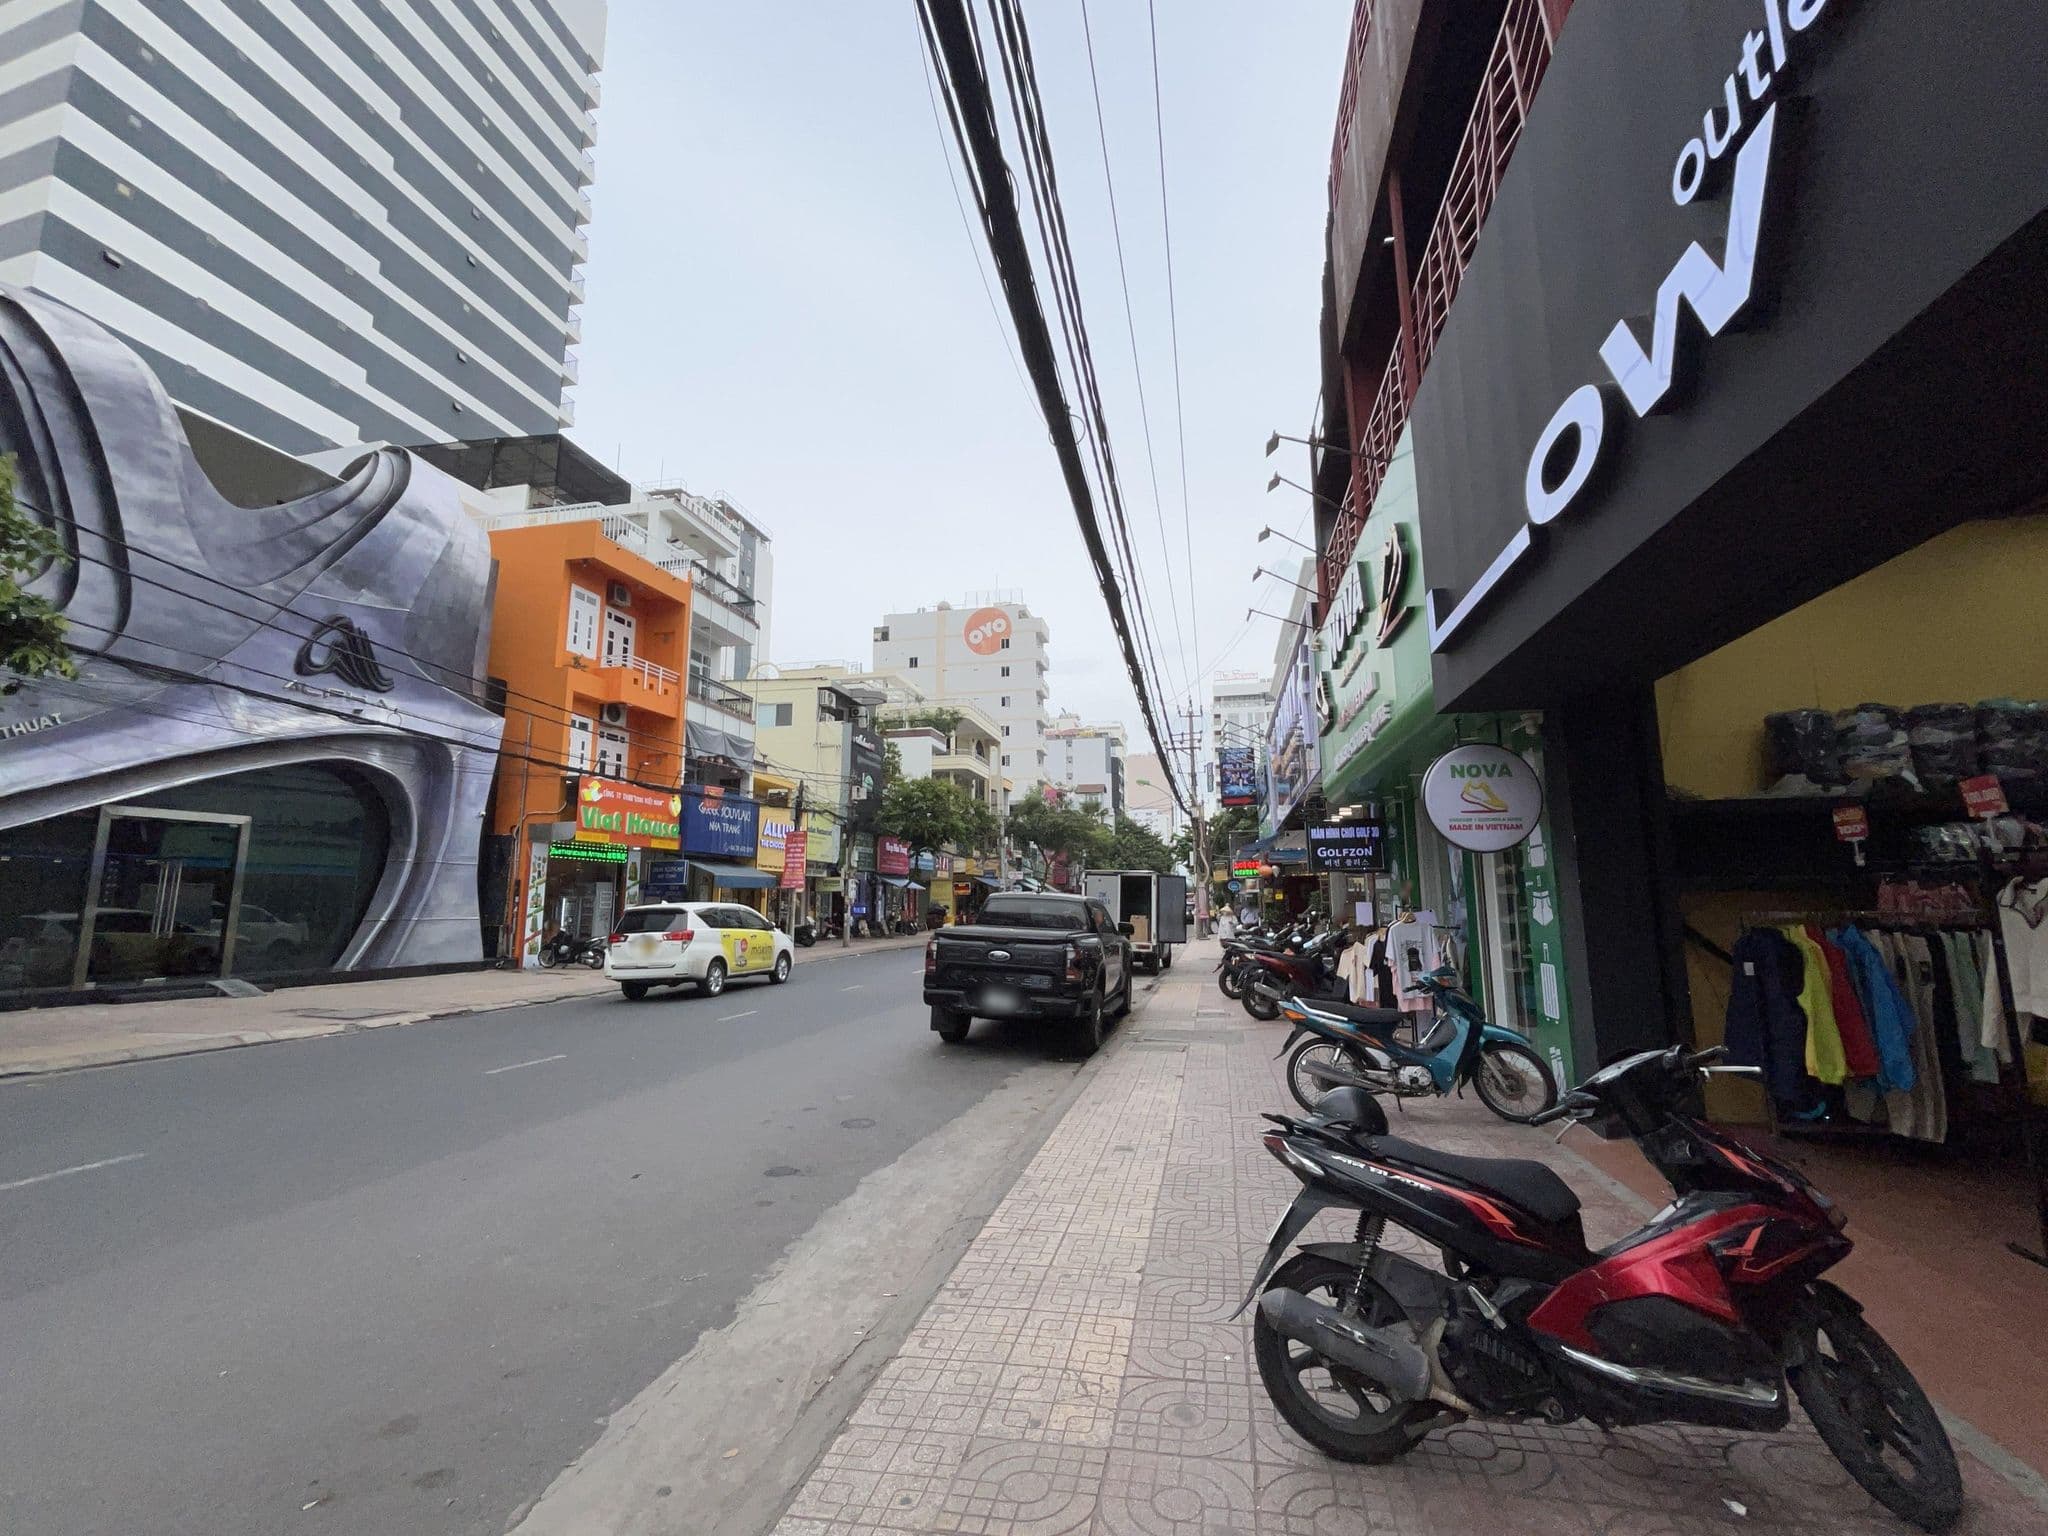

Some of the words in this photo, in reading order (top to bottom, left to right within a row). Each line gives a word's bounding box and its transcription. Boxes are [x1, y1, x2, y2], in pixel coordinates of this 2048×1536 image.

[969, 618, 1007, 646] OYO
[1450, 763, 1513, 778] NOVA
[625, 811, 680, 838] House
[1449, 823, 1474, 831] MADE
[1475, 823, 1484, 831] IN
[1486, 823, 1524, 831] VIETNAM
[1317, 846, 1373, 857] GOLFZON
